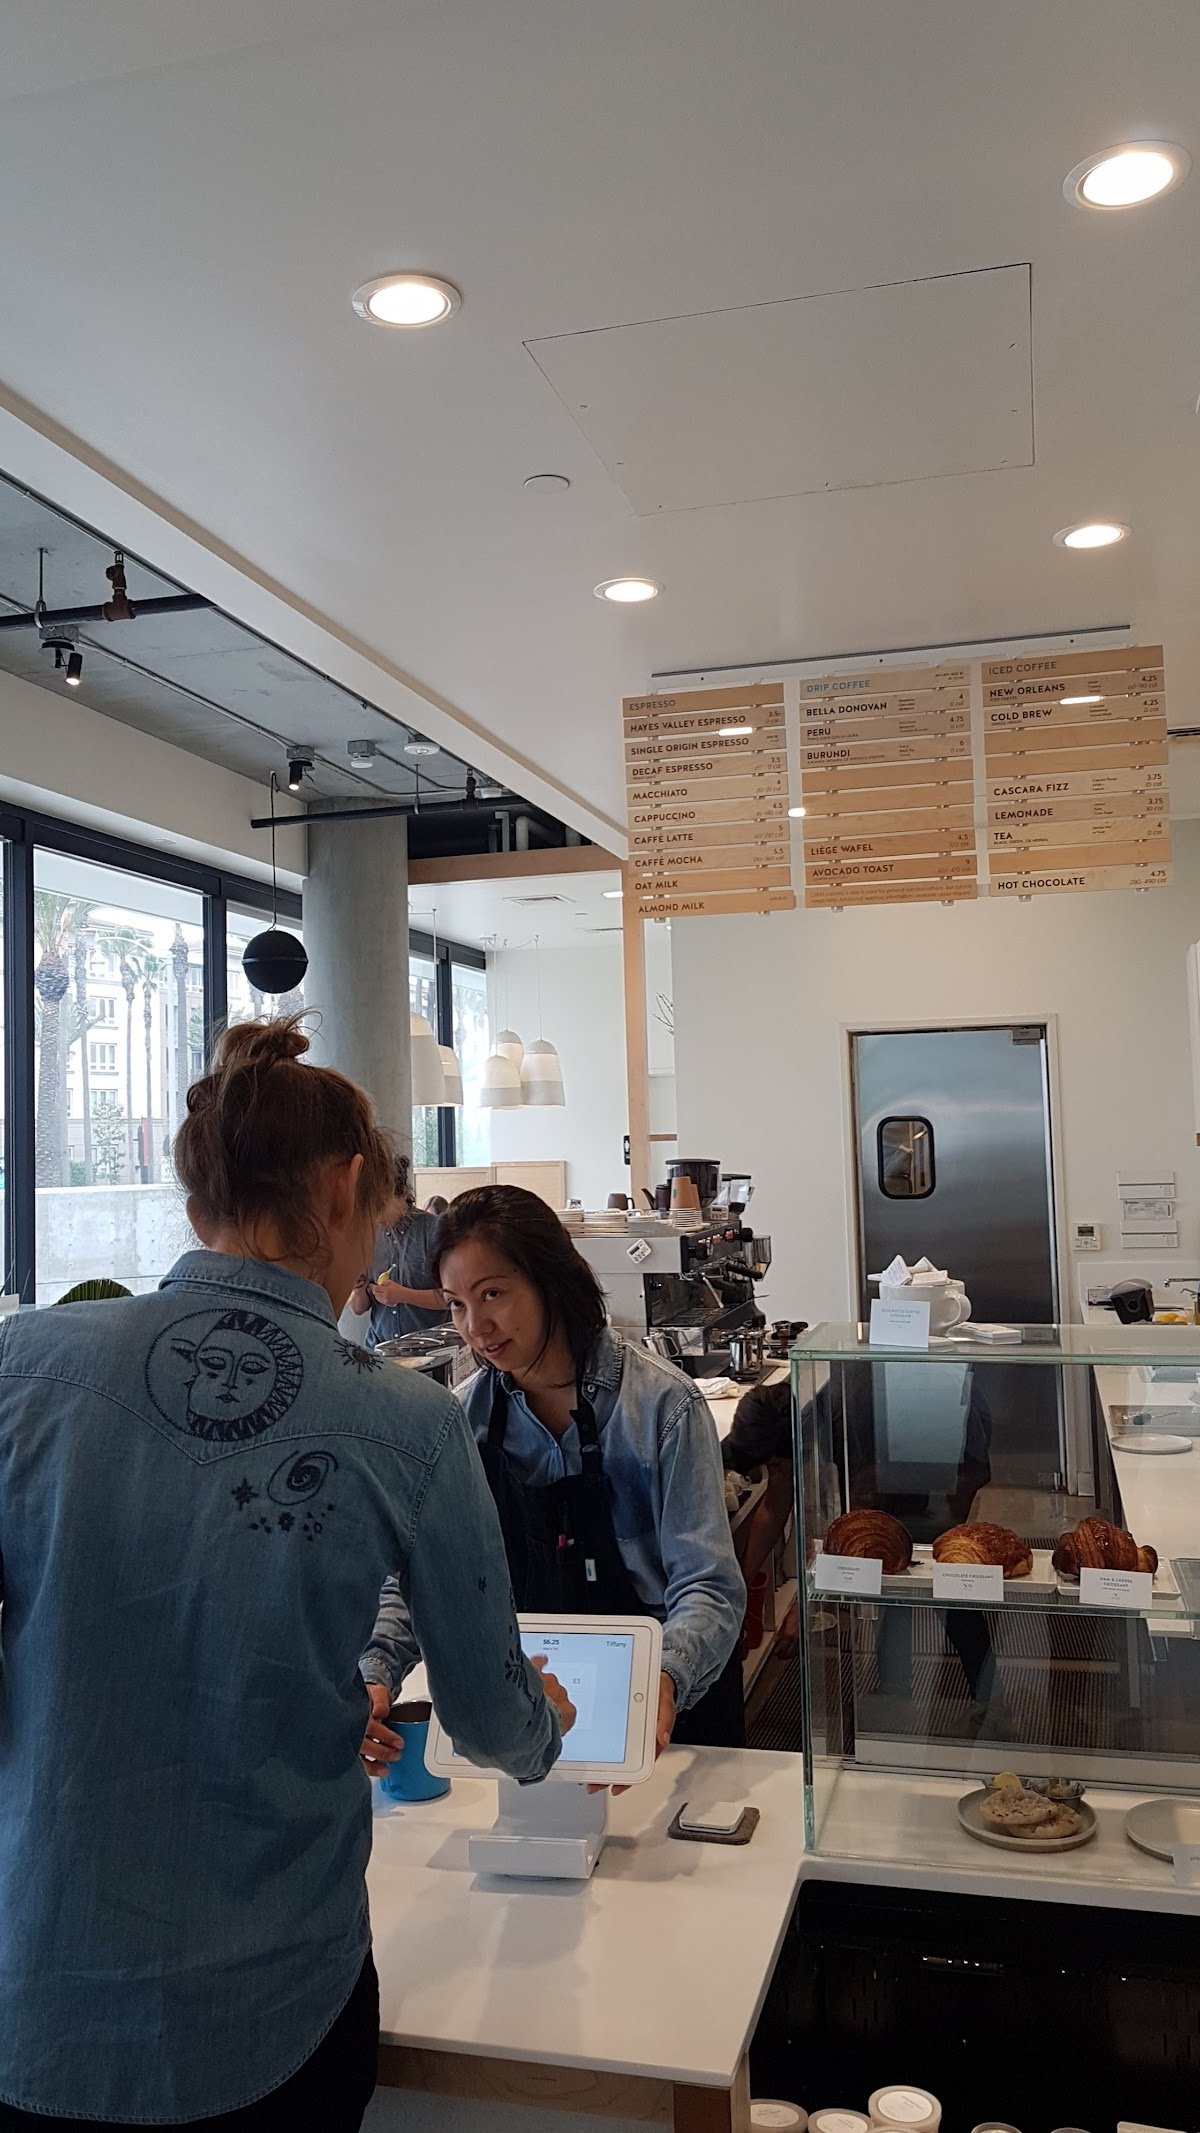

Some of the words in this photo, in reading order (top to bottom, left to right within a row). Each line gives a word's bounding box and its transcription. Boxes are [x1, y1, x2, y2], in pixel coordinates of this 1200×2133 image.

[989, 666, 1012, 675] ICED
[1017, 661, 1057, 672] COFFEE
[807, 684, 829, 693] DRIP
[832, 680, 870, 689] COFFEE
[990, 688, 1014, 697] NEW
[1018, 683, 1065, 695] ORLEANS
[629, 700, 676, 711] ESPRESSO
[807, 708, 835, 717] BELLA
[838, 702, 887, 713] DONOVAN
[991, 712, 1019, 721] COLD
[1022, 709, 1052, 719] BREW
[631, 721, 659, 732] HAYES
[662, 718, 695, 729] VALLEY
[698, 716, 746, 726] ESPRESSO
[807, 728, 831, 737] PERU
[631, 745, 663, 755] SINGLE
[666, 742, 698, 752] ORIGIN
[701, 738, 749, 749] ESPRESSO
[807, 750, 850, 760] BURUNDI
[632, 766, 662, 776] DECAF
[666, 762, 713, 773] ESPRESSO
[633, 789, 688, 800] MACCHIATO
[994, 785, 1043, 796] CASCARA
[1047, 783, 1069, 791] FIZZ
[634, 812, 696, 823] CAPPUCCINO
[995, 808, 1053, 820] LEMONADE
[634, 834, 664, 844] CAFFÈ
[667, 833, 694, 842] LATTE
[994, 832, 1013, 840] TEA
[811, 845, 838, 855] LIÈGE
[841, 844, 873, 852] WAFEL
[635, 856, 664, 867] CAFFÈ
[668, 856, 703, 865] MOCHA
[812, 866, 860, 877] AVOCADO
[863, 864, 894, 873] TOAST
[656, 880, 679, 889] MILK
[998, 881, 1018, 890] HOT
[1022, 877, 1085, 888] CHOCOLATE
[639, 903, 678, 913] ALMOND
[682, 902, 704, 910] MILK
